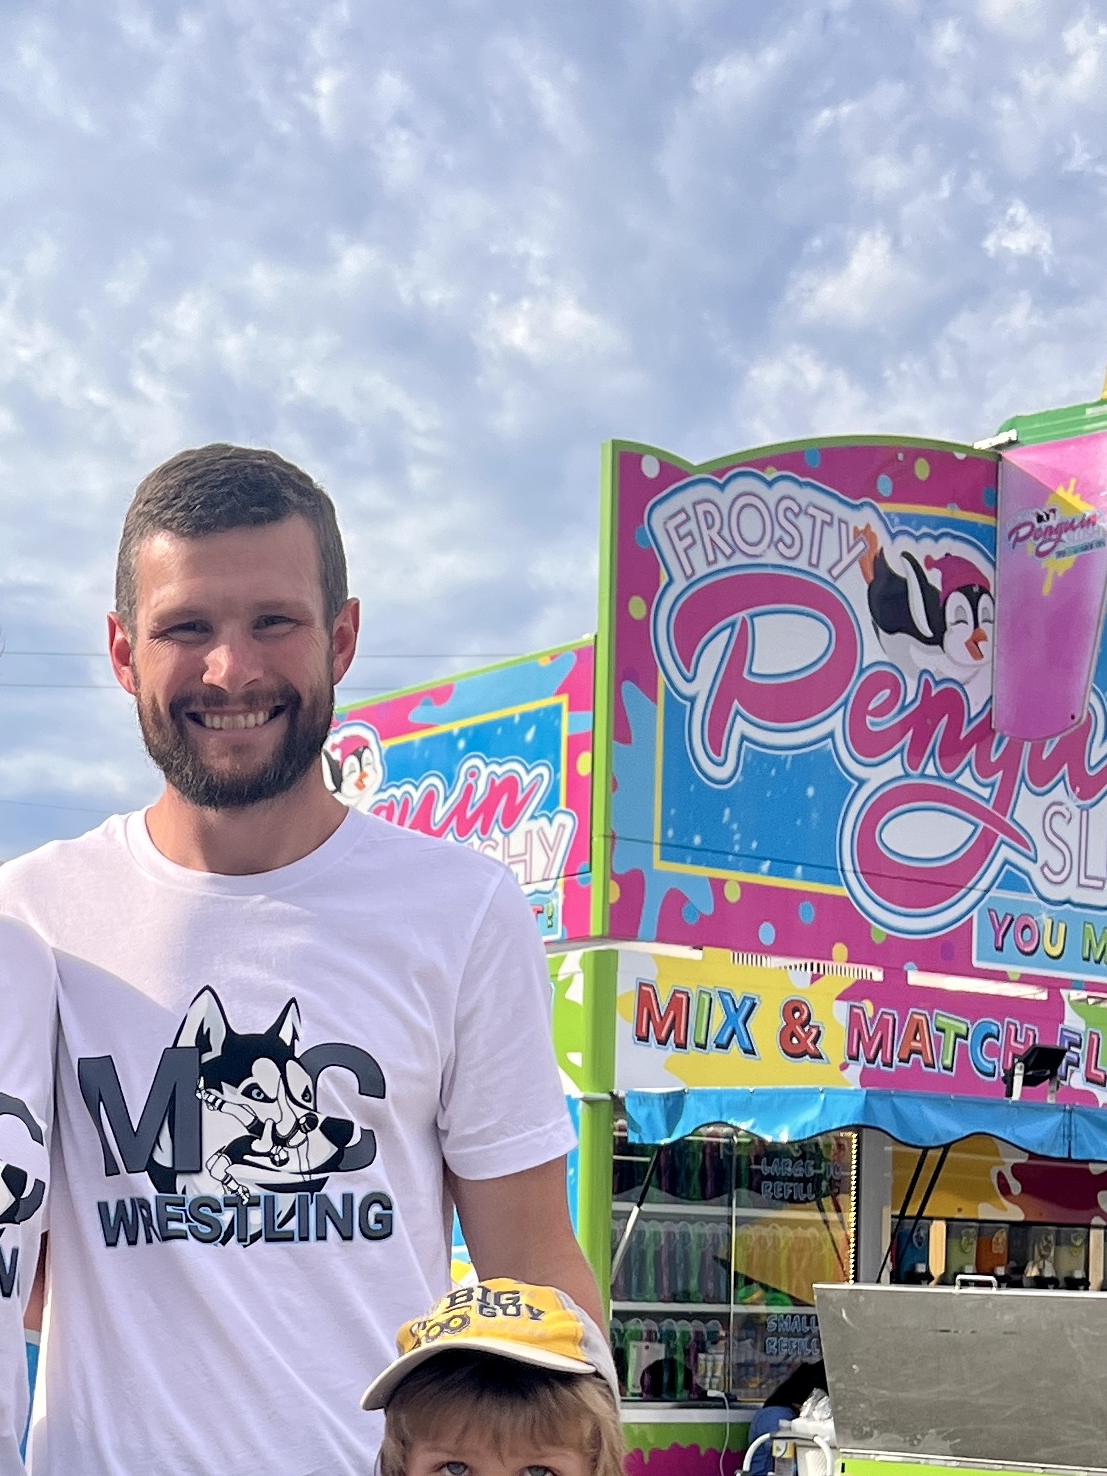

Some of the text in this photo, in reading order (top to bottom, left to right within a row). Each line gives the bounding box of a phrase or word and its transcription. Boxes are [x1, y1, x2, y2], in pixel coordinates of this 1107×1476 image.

[664, 491, 869, 582] FROSTY
[988, 908, 1067, 960] YOU
[635, 980, 759, 1058] MIX
[777, 997, 829, 1063] &
[846, 1002, 1039, 1080] MATCH
[761, 1158, 814, 1178] LARGE
[761, 1181, 816, 1201] REFILL
[97, 1191, 394, 1248] WRESTLING
[446, 1285, 521, 1309] BIG
[478, 1303, 545, 1321] GUY
[766, 1314, 819, 1333] SMALL
[765, 1336, 821, 1356] REFILL
